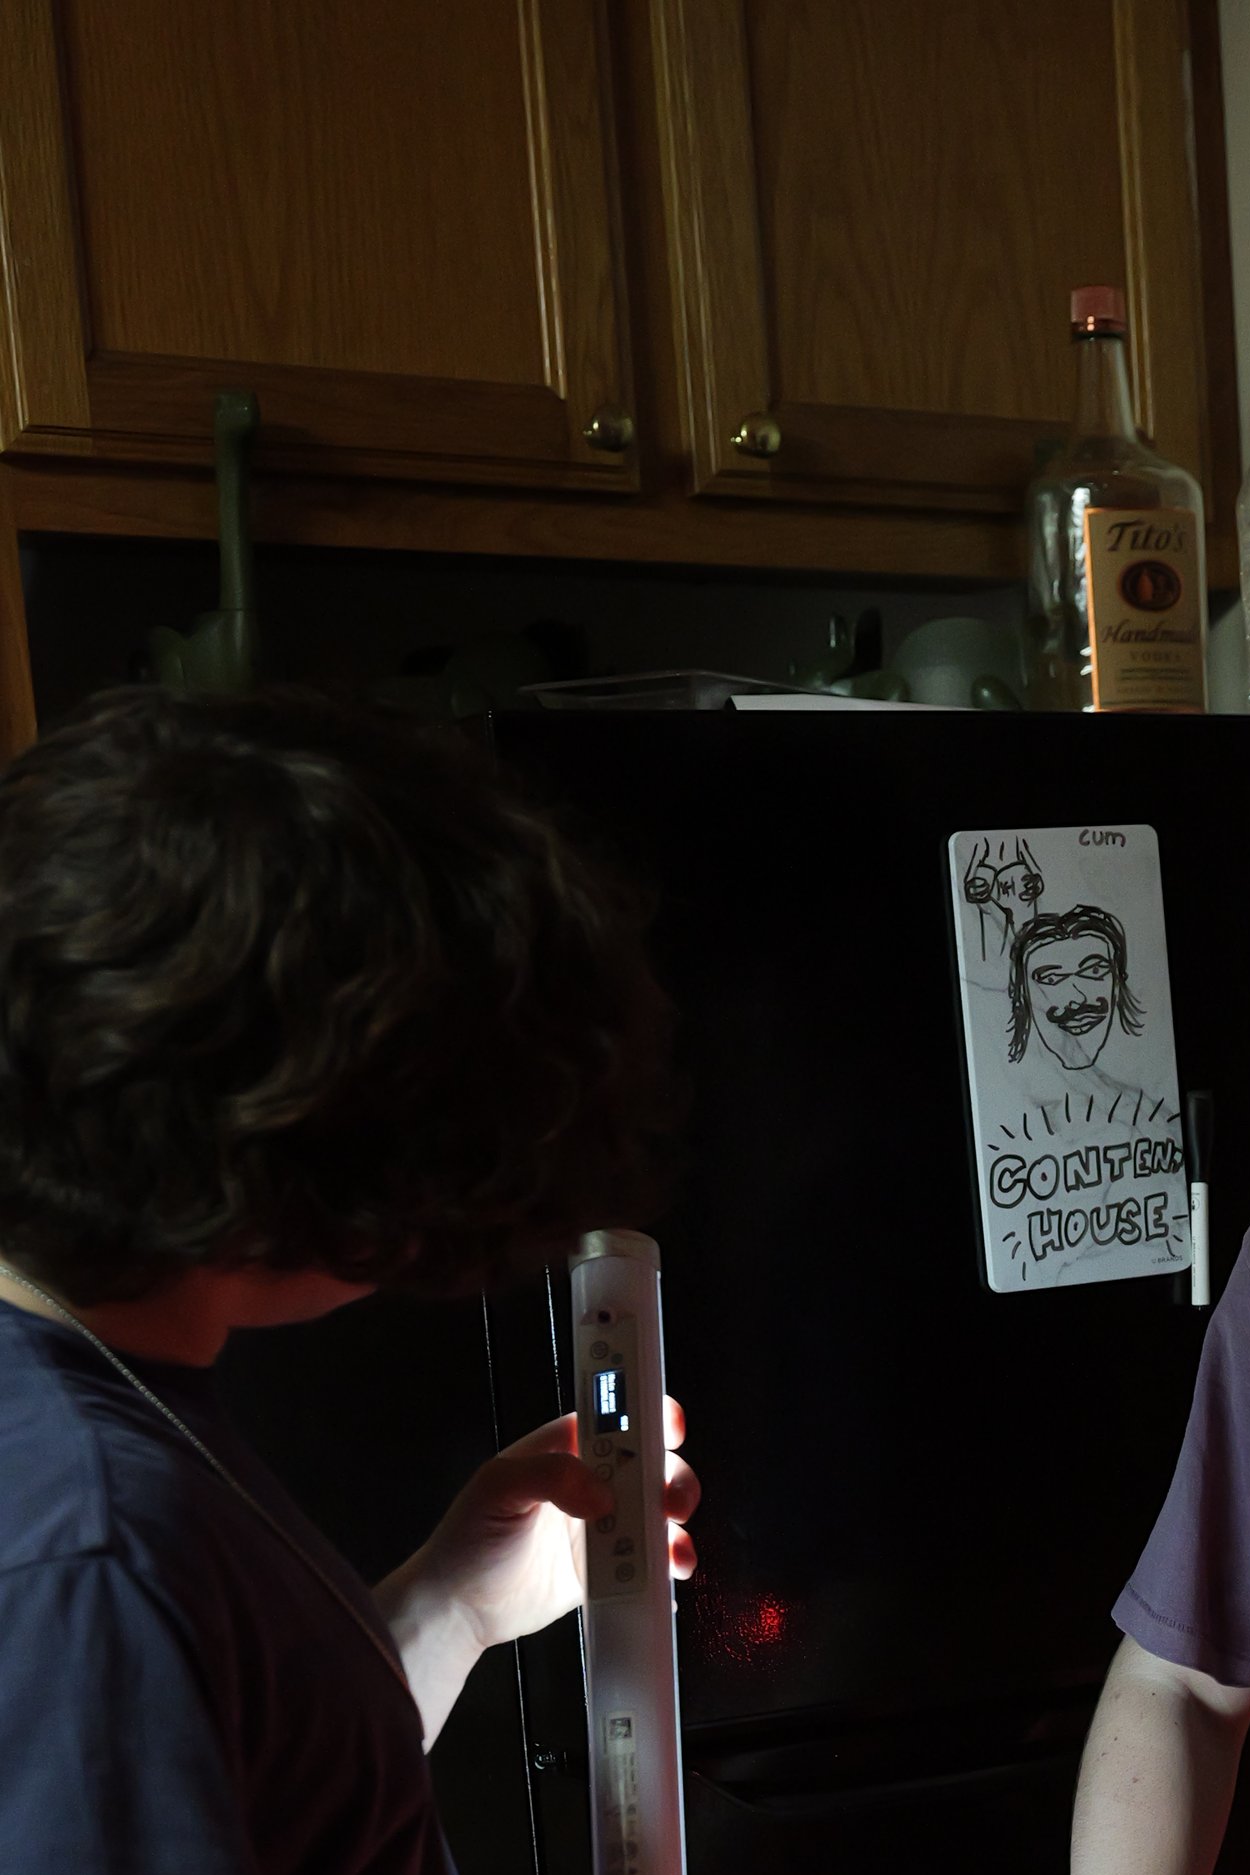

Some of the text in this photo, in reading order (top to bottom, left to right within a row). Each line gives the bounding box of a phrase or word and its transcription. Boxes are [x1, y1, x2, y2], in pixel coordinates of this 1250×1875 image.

[1107, 519, 1185, 553] Tito's
[1027, 1192, 1168, 1261] HOUSE
[1157, 1255, 1183, 1263] BRANDS
